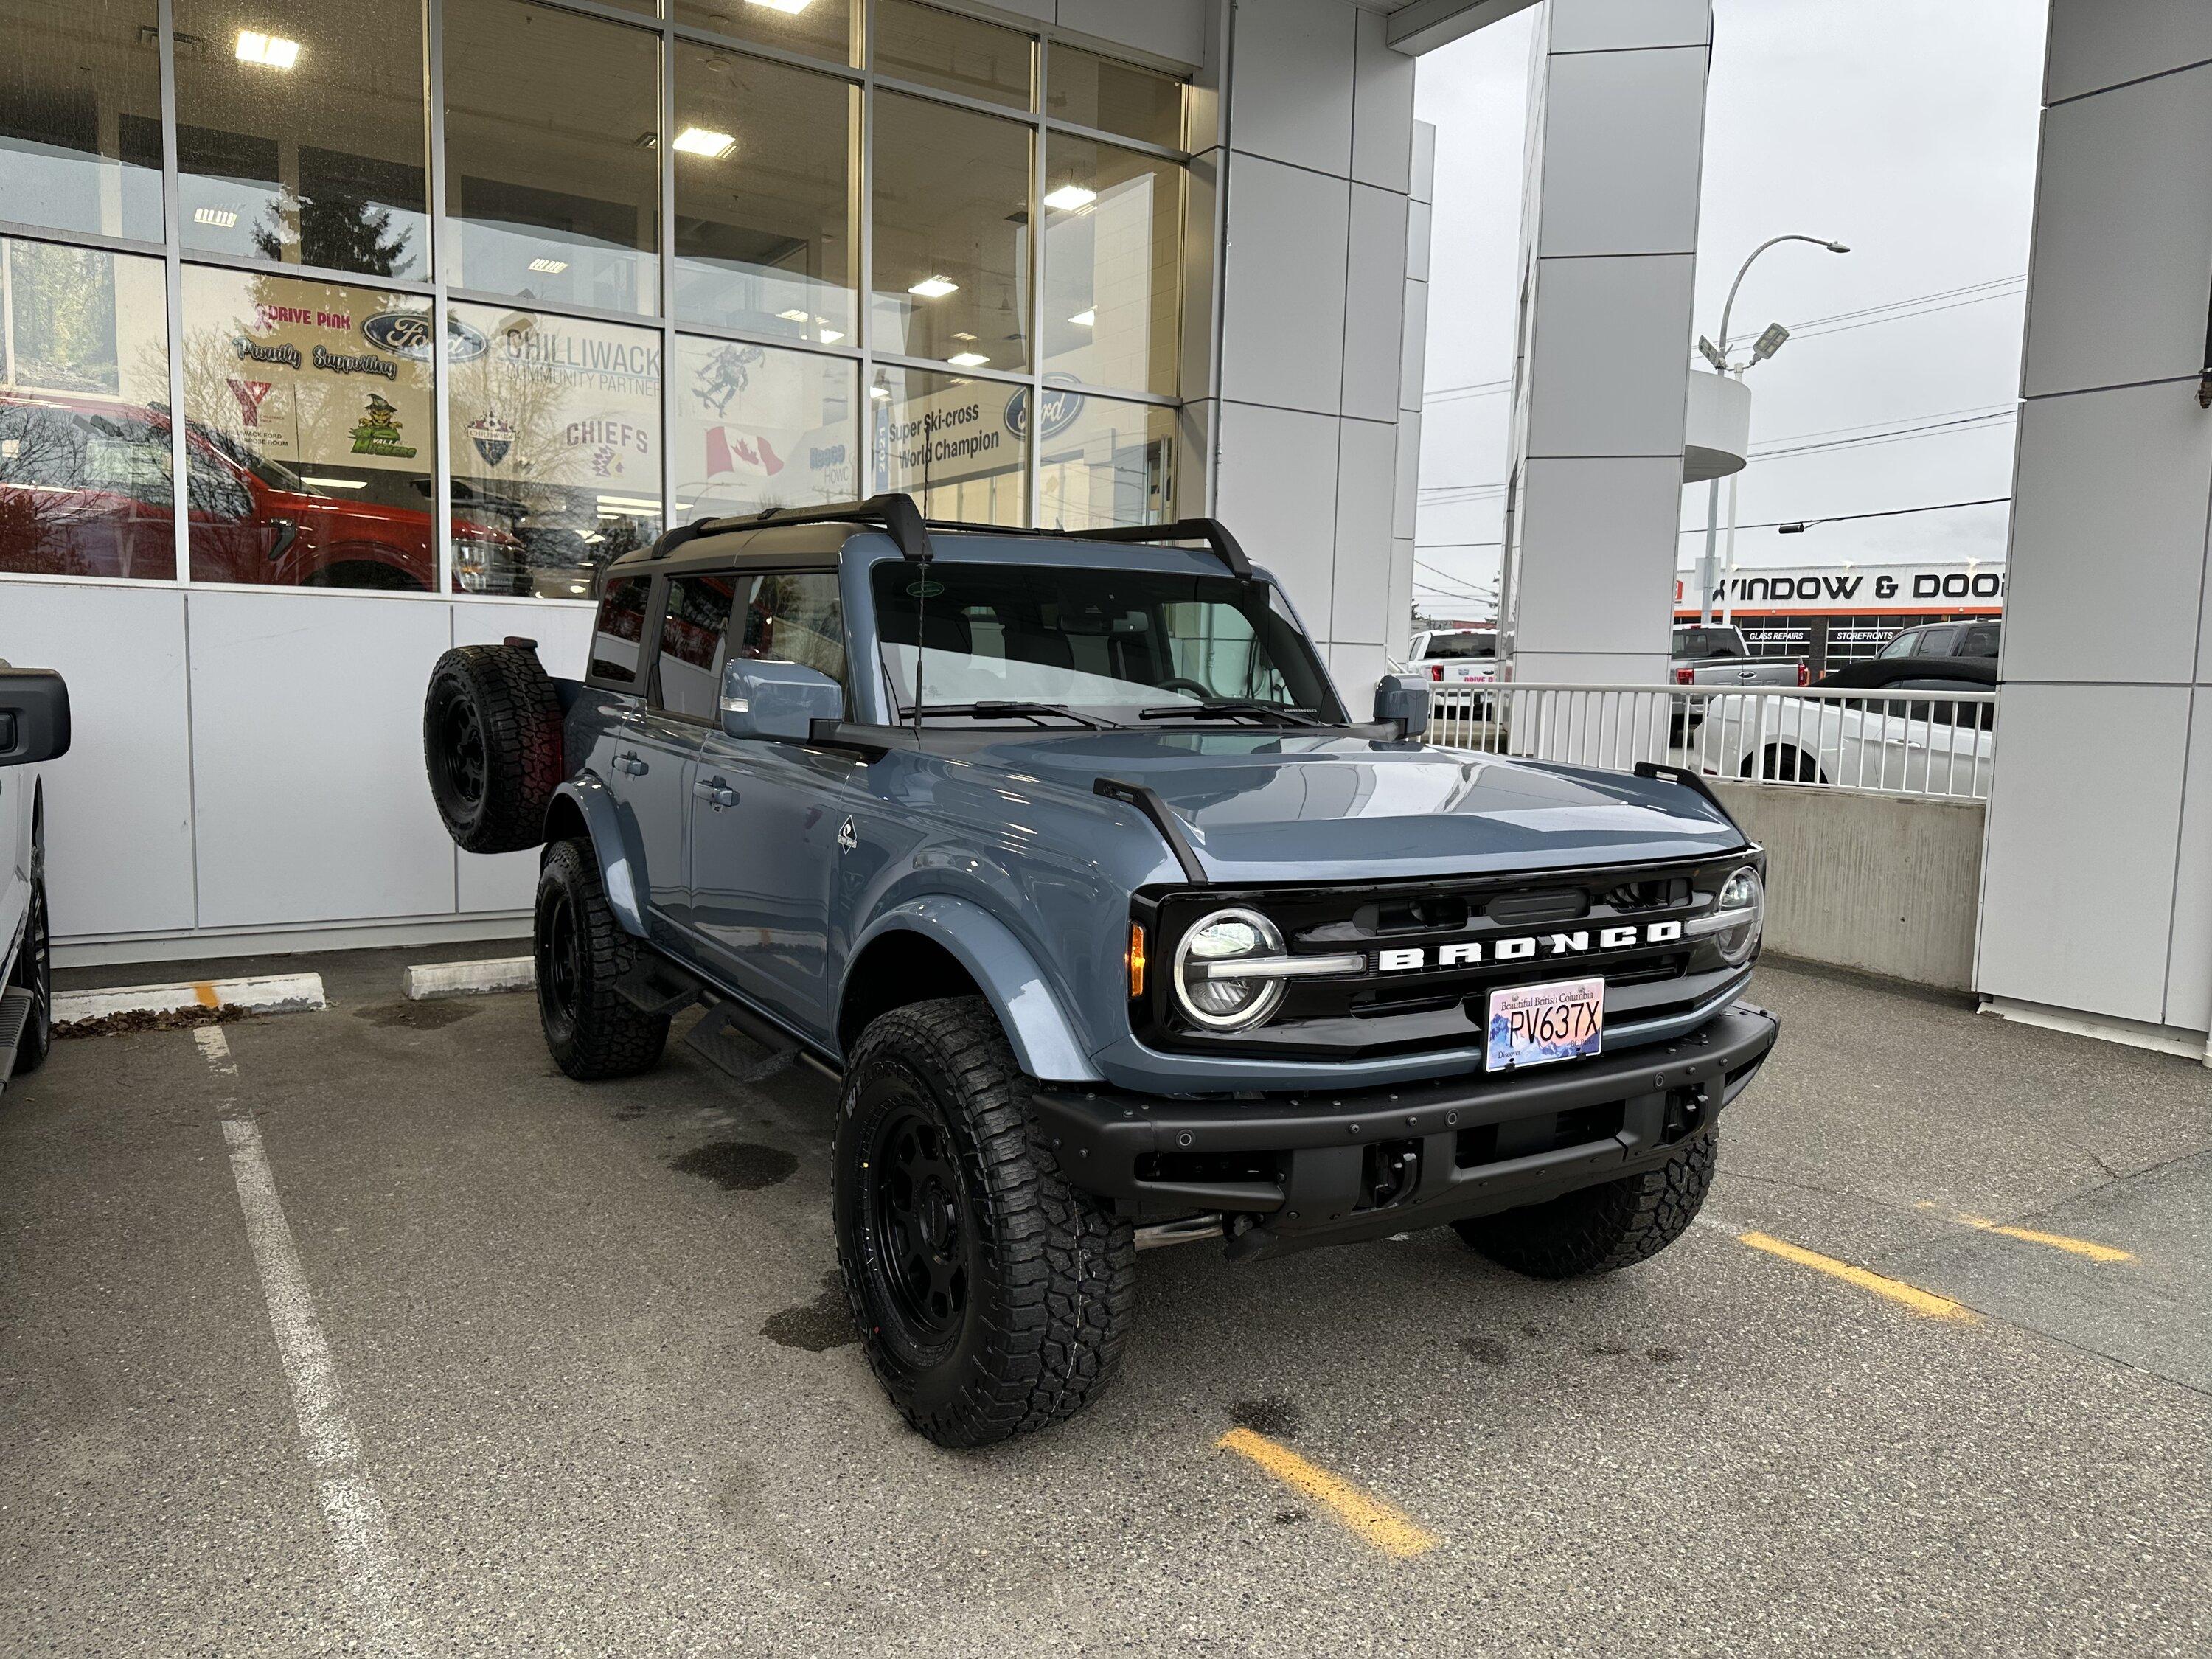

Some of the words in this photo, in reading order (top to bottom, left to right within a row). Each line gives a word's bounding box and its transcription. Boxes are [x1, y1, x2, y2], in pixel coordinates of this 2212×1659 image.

[268, 305, 312, 325] DRIVE
[316, 311, 351, 330] PINK
[386, 316, 465, 355] Fod
[232, 336, 302, 369] Proudly
[313, 344, 397, 382] Supporting
[507, 329, 661, 377] CHILLIWACK
[507, 362, 595, 388] COMMUNITY
[566, 421, 648, 454] CHIEFS
[889, 420, 922, 443] Super
[924, 403, 979, 434] Ski-cross
[810, 445, 846, 470] Reece
[900, 442, 933, 469] World
[935, 429, 999, 462] Champion
[1875, 575, 1899, 598] &
[1913, 573, 2005, 598] DOO
[1750, 632, 1773, 640] GLASS
[1773, 632, 1804, 640] REPAIRS
[1837, 631, 1893, 640] STOREFRONTS
[1378, 920, 1681, 972] BRONCO
[1501, 998, 1533, 1011] Beautiful
[1534, 995, 1558, 1006] British
[1559, 991, 1594, 1003] Columbia
[1510, 1001, 1600, 1047] PV637X
[1498, 1050, 1521, 1059] Discover
